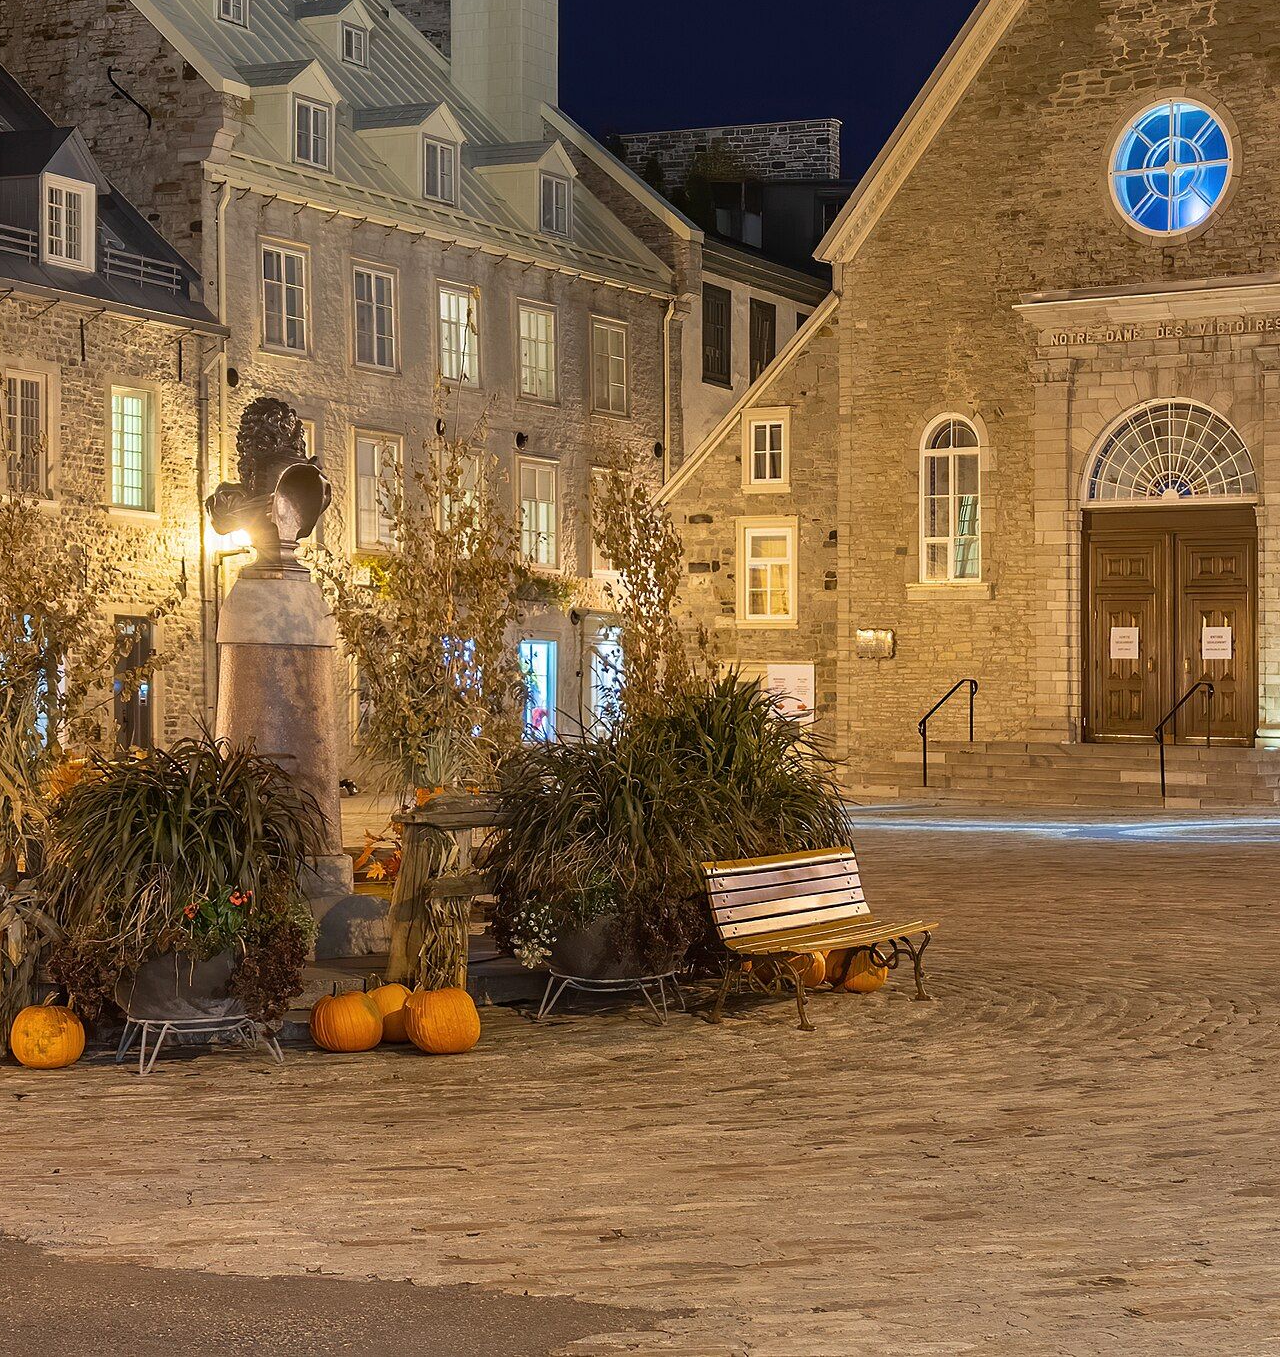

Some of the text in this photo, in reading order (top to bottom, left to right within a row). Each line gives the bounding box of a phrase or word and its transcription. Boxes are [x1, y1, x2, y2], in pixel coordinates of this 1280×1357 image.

[1050, 333, 1094, 346] NOTRE
[1106, 328, 1141, 342] DAME
[1156, 326, 1184, 339] DES
